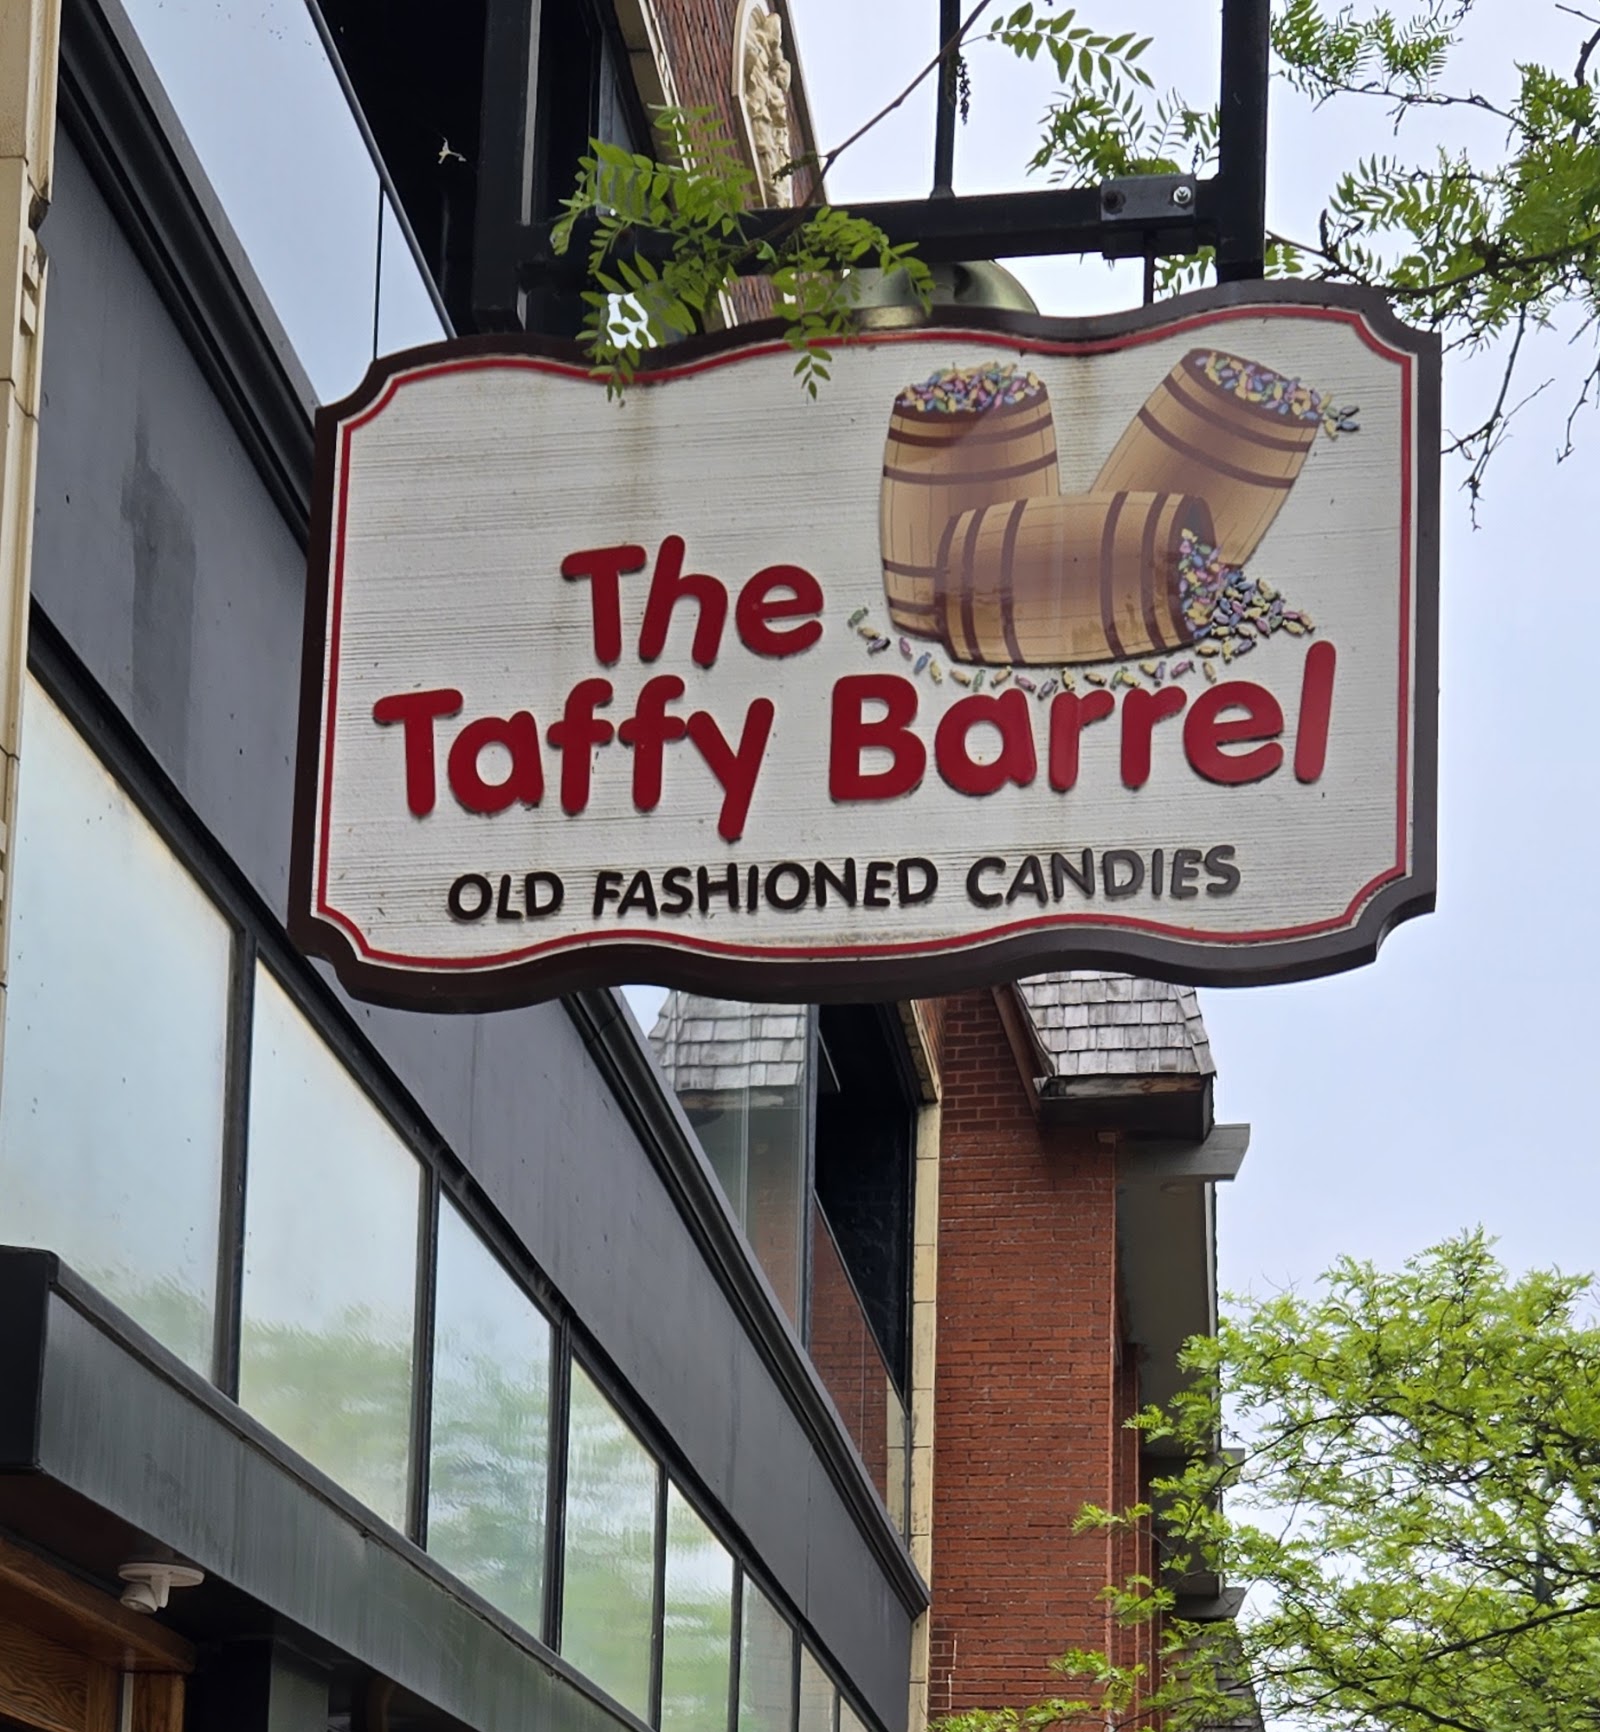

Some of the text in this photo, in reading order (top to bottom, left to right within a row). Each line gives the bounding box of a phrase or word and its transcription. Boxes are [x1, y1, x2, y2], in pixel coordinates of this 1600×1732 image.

[560, 534, 825, 668] The
[373, 639, 1337, 843] Taffy Barrel
[446, 844, 1242, 923] OLD FASHIONED CANDIES
